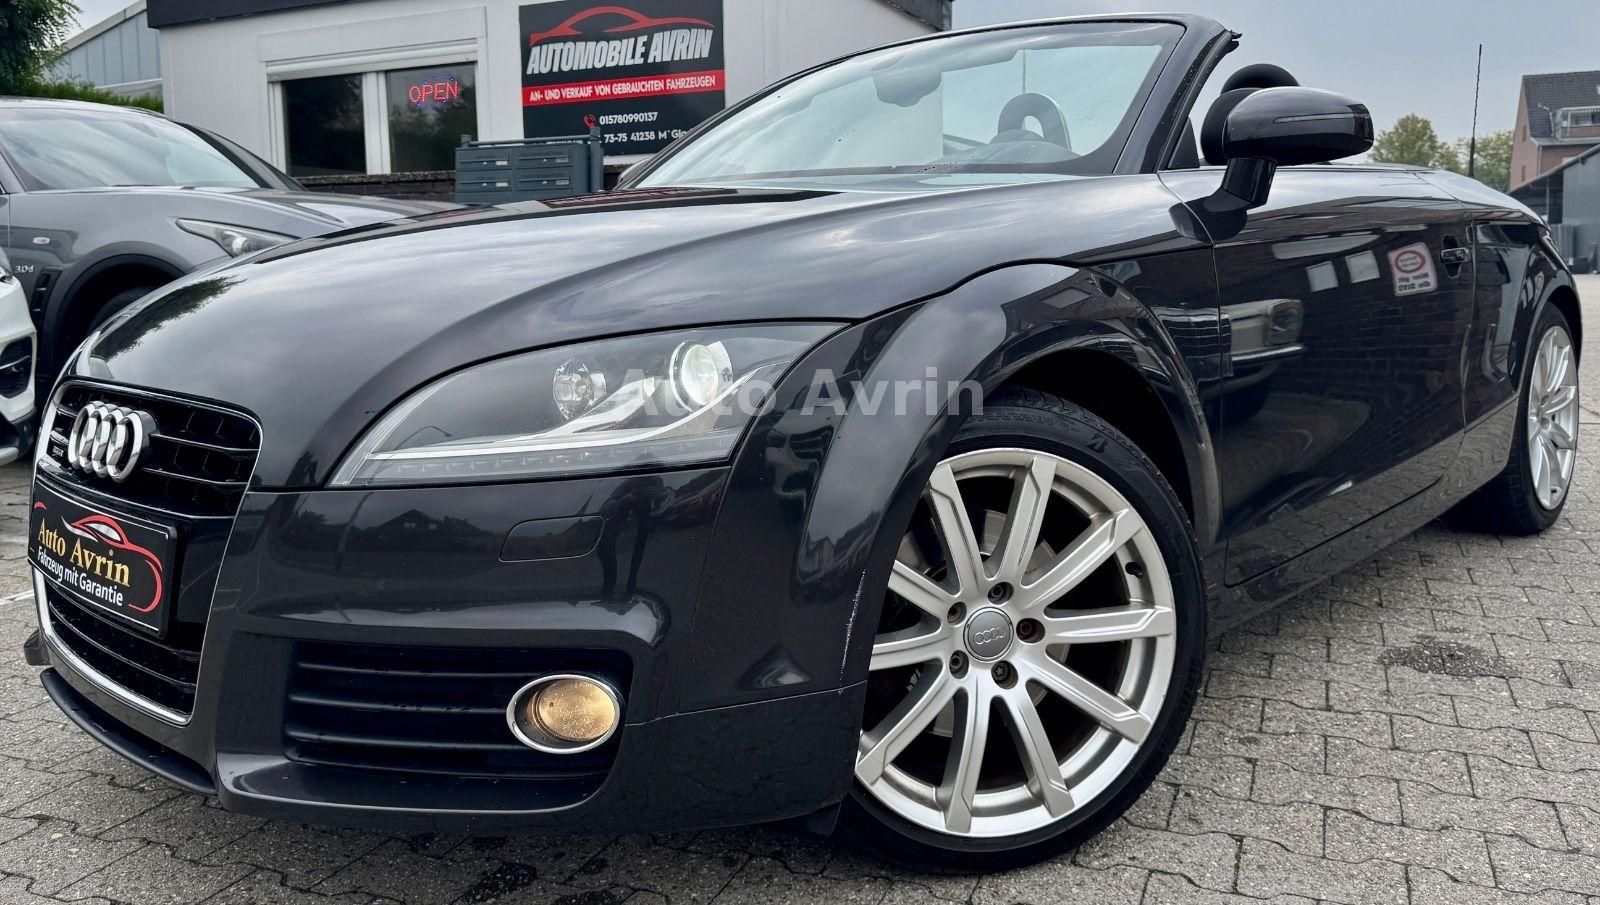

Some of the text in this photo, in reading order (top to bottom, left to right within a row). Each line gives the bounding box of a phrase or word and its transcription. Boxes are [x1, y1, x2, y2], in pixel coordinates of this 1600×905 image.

[526, 28, 714, 75] AUTOMOBILE AVRIN
[409, 81, 459, 103] OPEN
[529, 75, 716, 102] AN- UND VERKAUF VON GEBRAUCHTEN FAHRZEUGEN
[599, 112, 658, 125] 015780990137
[603, 133, 628, 143] 73-75
[630, 131, 656, 141] 41238
[37, 517, 130, 587] Auto Avrin
[37, 546, 124, 606] Fahrzeug mit Garantie
